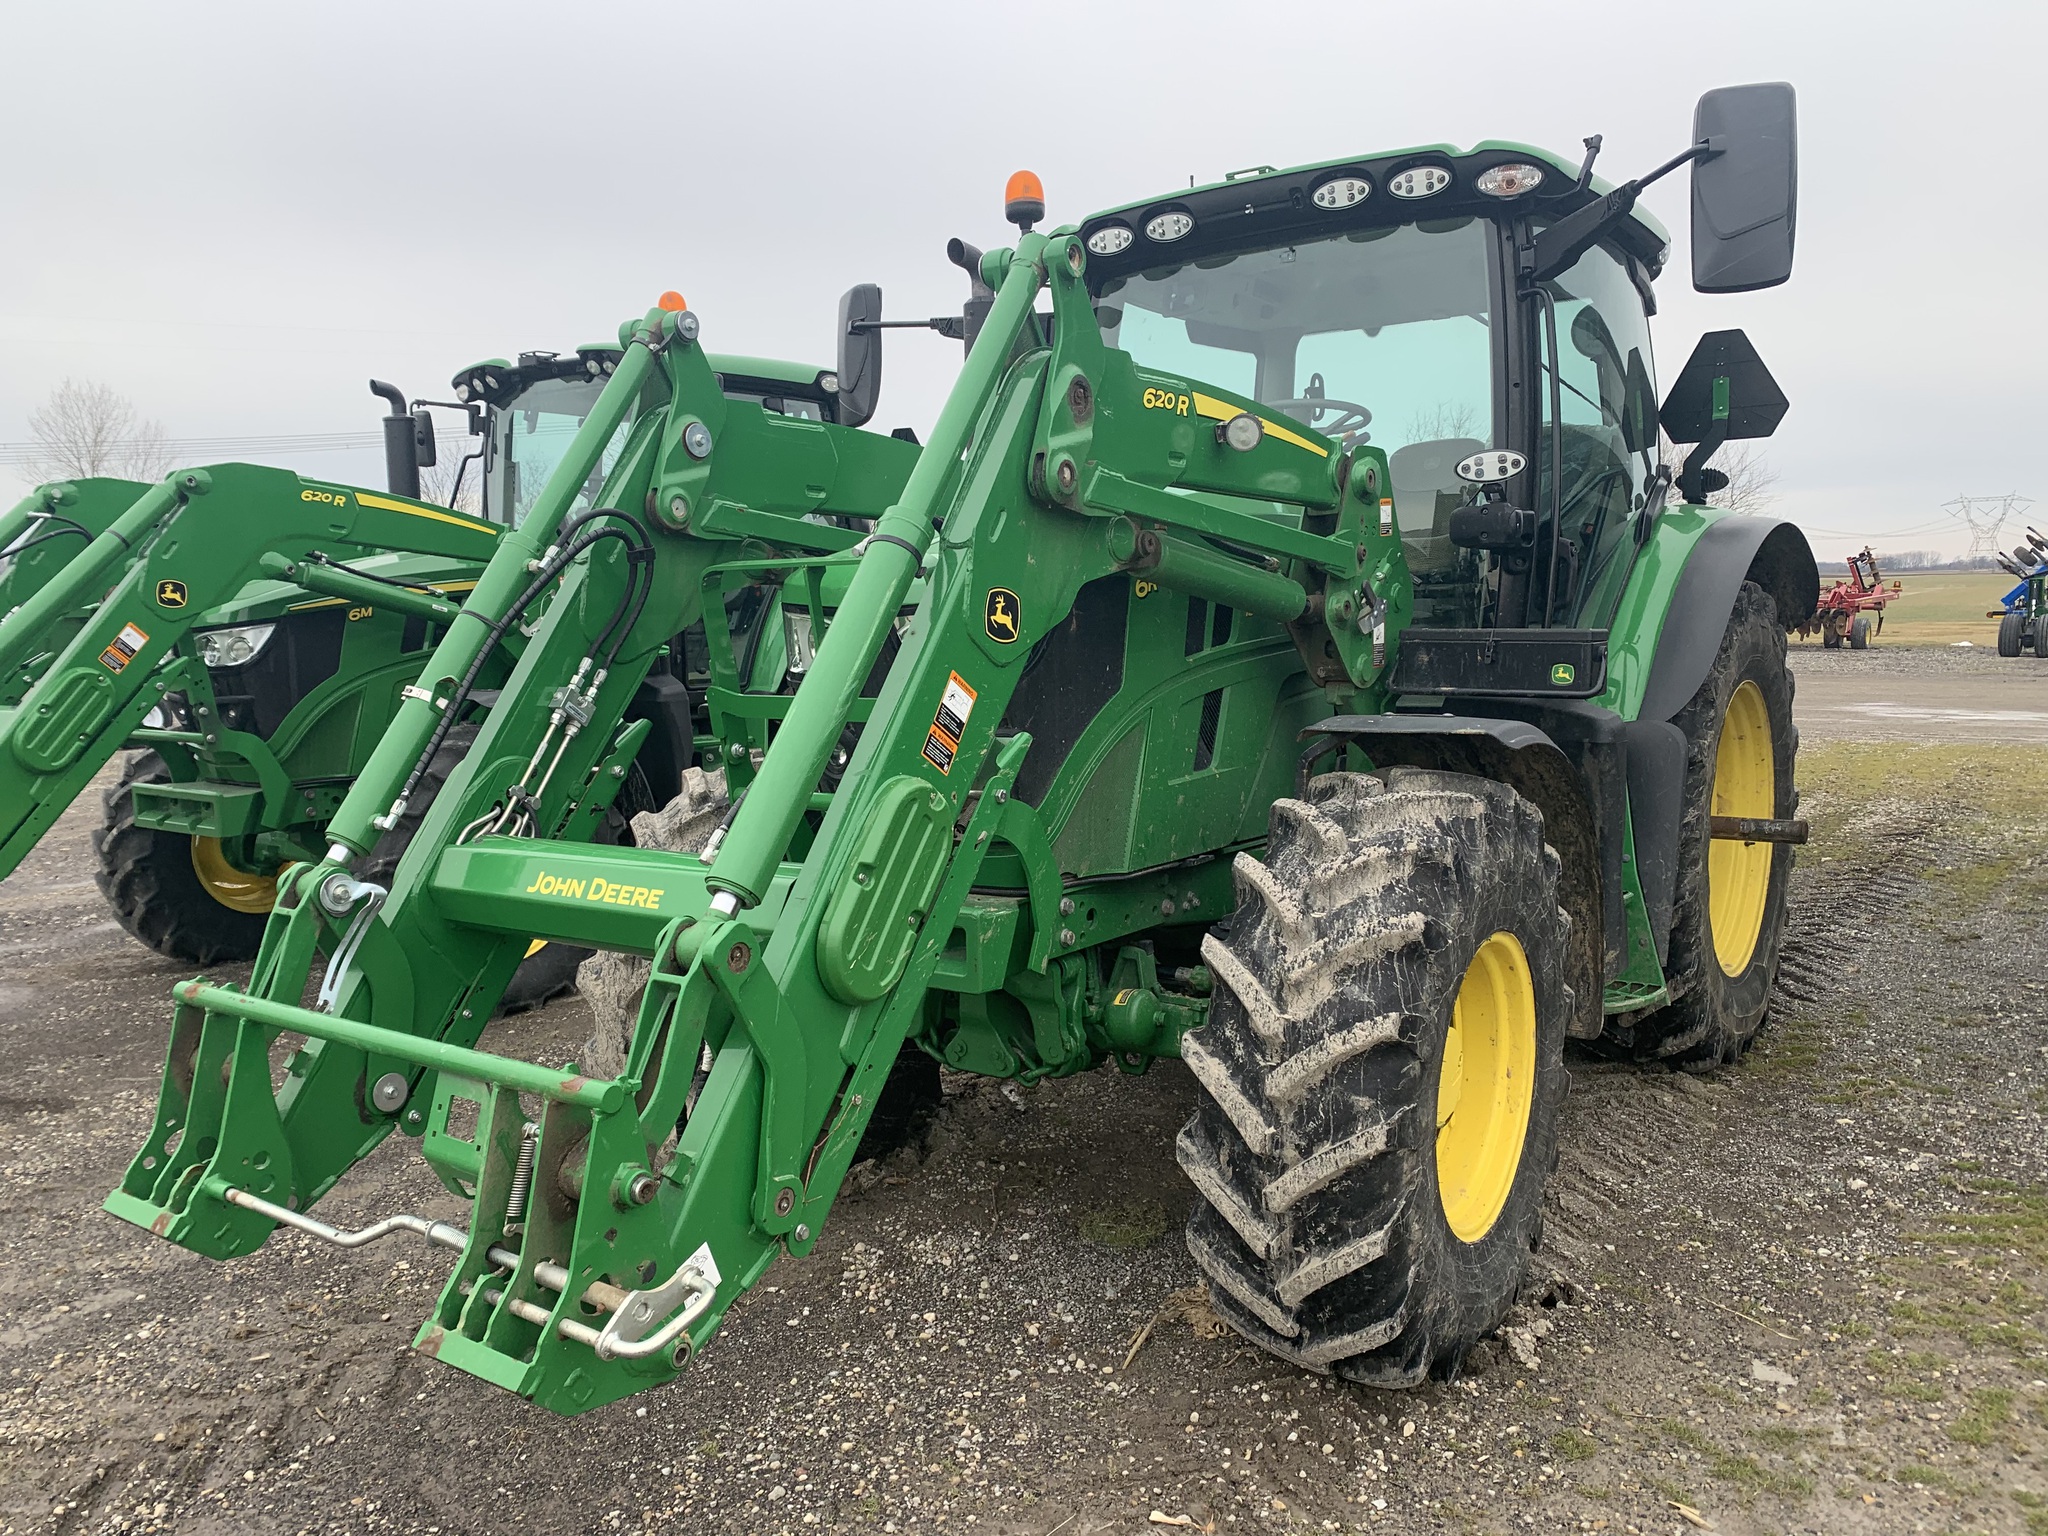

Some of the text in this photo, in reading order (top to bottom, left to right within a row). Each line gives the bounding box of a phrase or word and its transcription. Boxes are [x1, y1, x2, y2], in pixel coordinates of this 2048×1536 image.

[1142, 387, 1190, 417] 620 R
[300, 489, 347, 507] 620 R
[348, 606, 373, 621] 6M
[526, 871, 665, 910] JOHN DEERE
